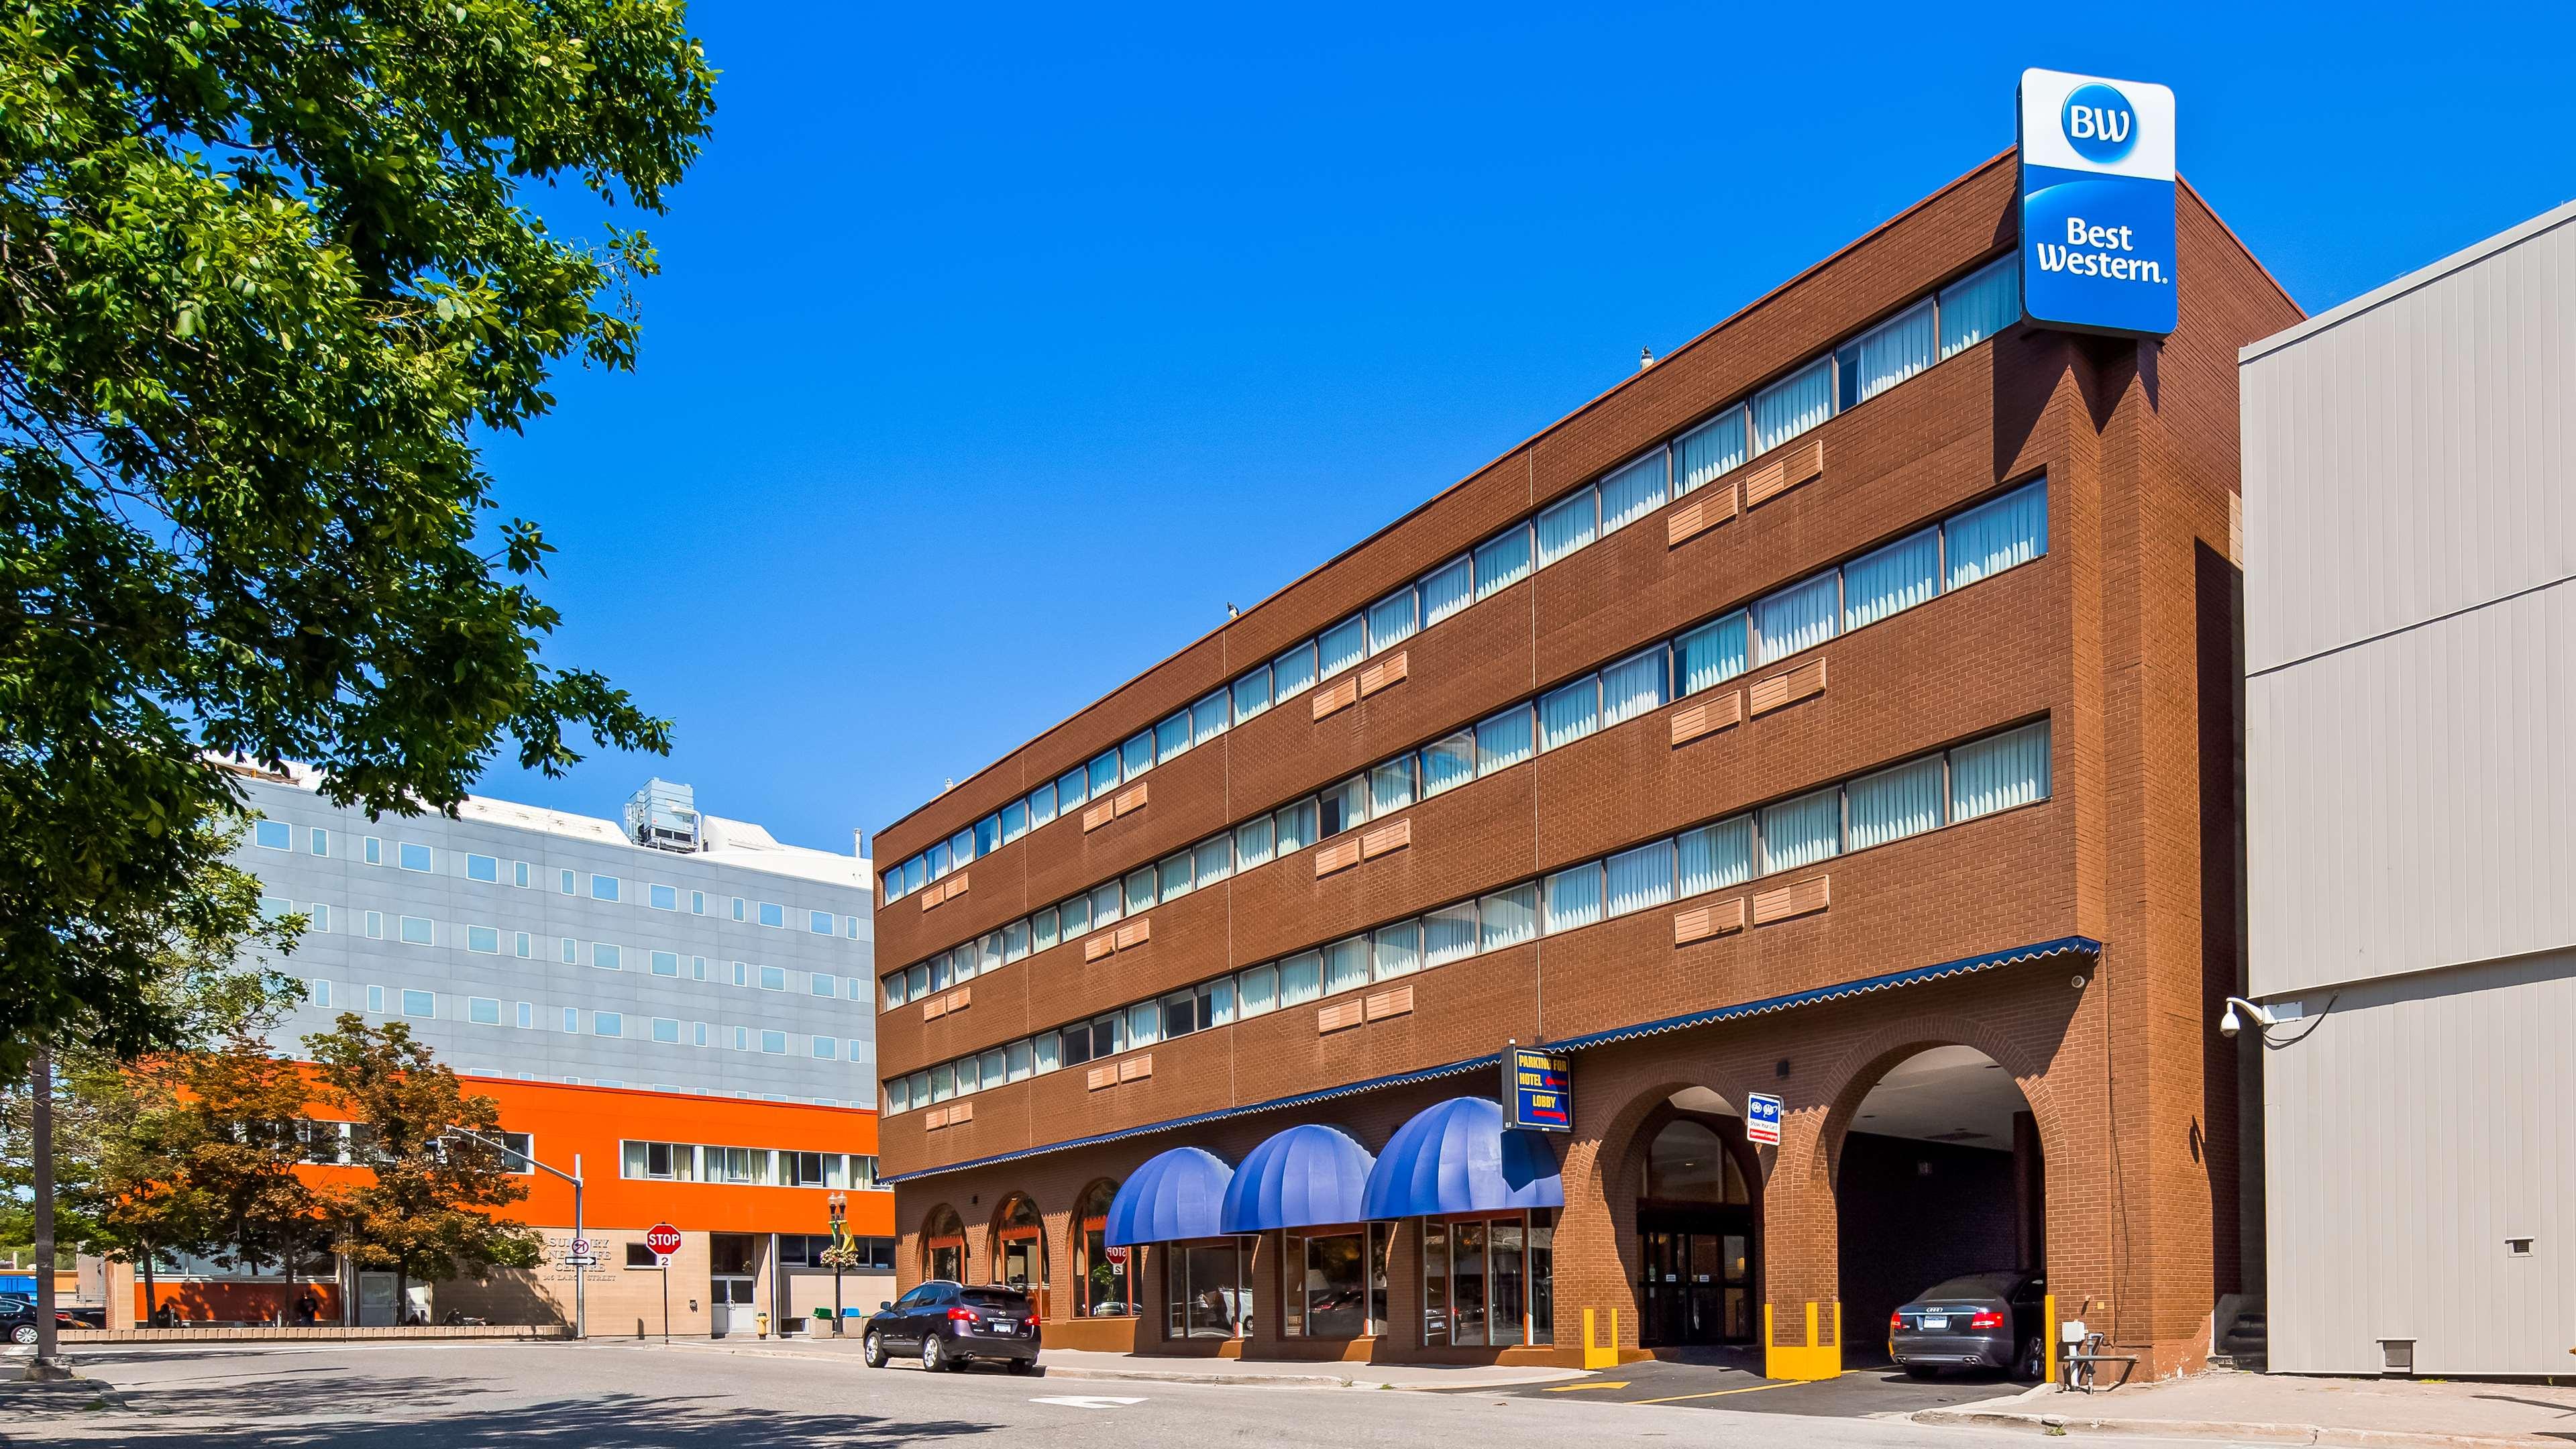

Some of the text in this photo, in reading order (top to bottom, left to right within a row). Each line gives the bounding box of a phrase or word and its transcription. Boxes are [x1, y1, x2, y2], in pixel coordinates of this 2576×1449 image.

[2070, 105, 2130, 143] BW
[2067, 217, 2134, 252] Best
[1518, 1055, 1567, 1072] PARKING FOR
[1519, 1072, 1542, 1087] HOTEL
[1532, 1094, 1556, 1108] LOBBY
[649, 1234, 680, 1246] STOP
[661, 1256, 669, 1266] 2
